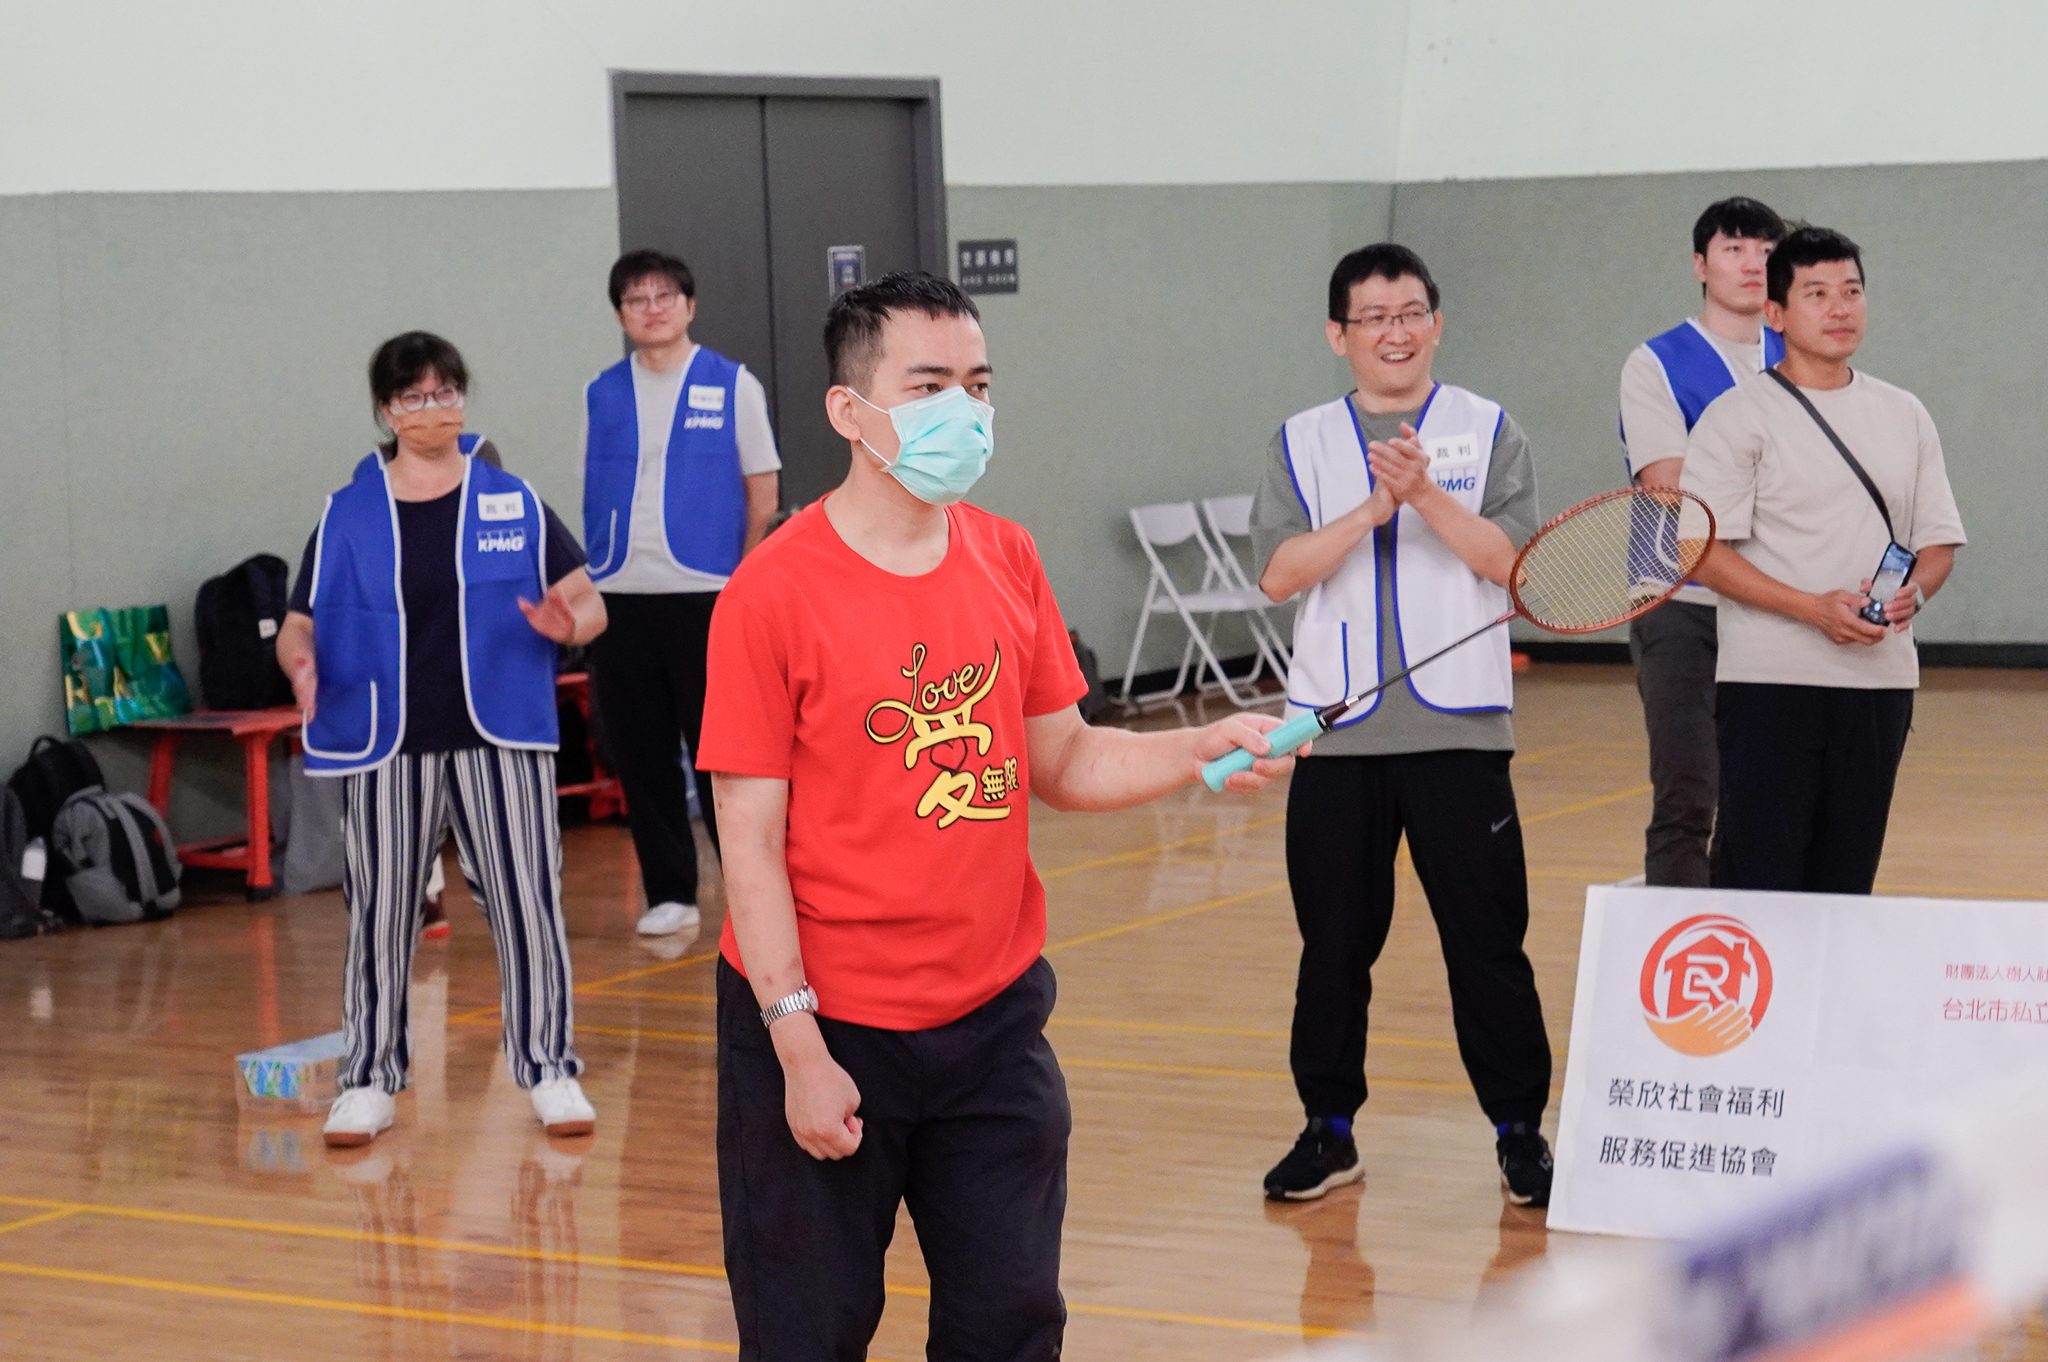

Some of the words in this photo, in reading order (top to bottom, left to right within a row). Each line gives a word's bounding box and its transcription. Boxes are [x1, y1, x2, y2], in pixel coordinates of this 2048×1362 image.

[1437, 476, 1476, 492] PMG
[477, 535, 525, 553] KPMG
[1608, 1077, 1785, 1119] 榮欣社會福利
[1600, 1135, 1778, 1177] 服務促進協會
